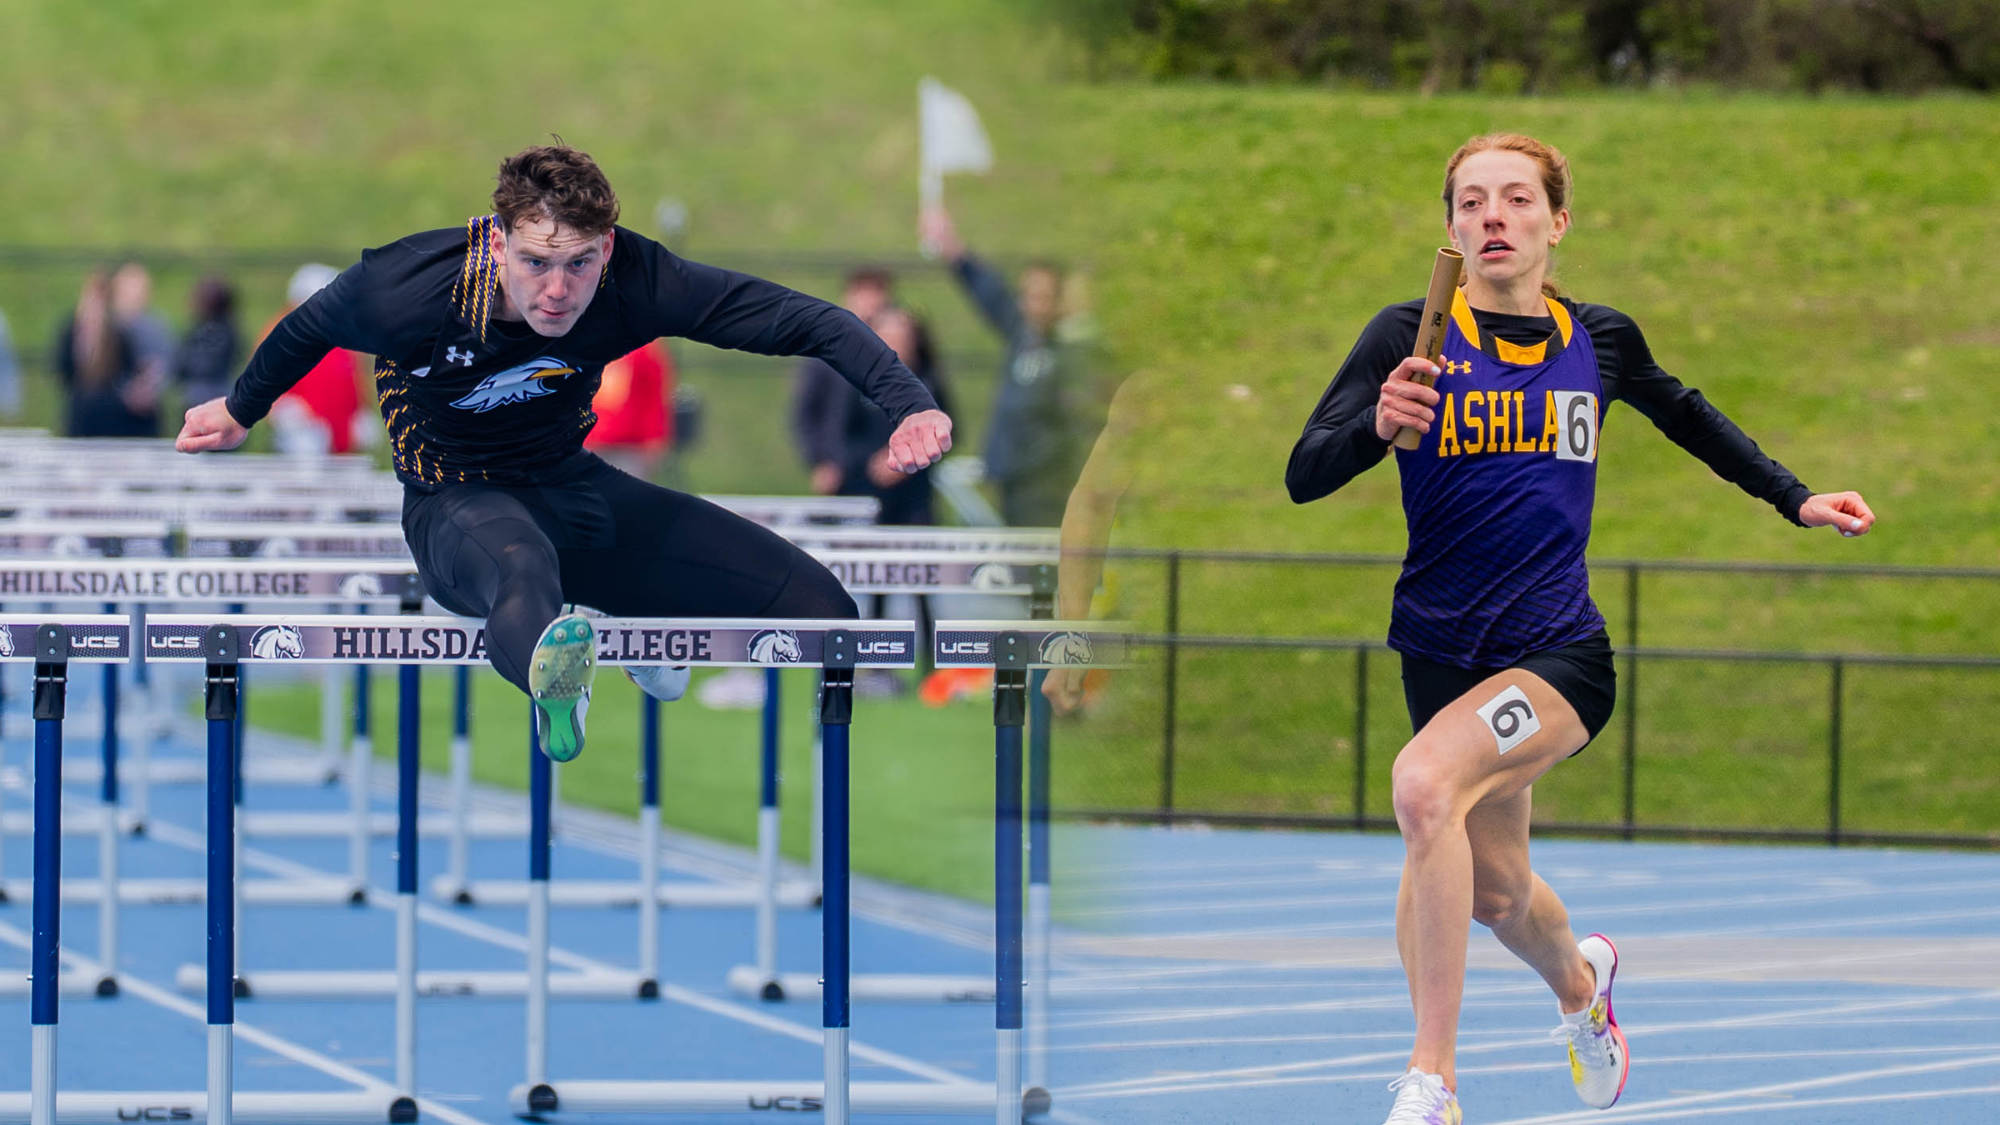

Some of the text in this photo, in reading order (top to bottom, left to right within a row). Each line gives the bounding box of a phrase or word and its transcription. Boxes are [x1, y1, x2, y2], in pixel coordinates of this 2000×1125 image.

[1438, 390, 1599, 460] ASHLA
[1567, 394, 1590, 457] 6
[828, 562, 941, 585] OLLEGE
[1, 570, 310, 597] HILLSDALE COLLEGE
[71, 635, 120, 648] UCS
[151, 635, 200, 648] UCS
[333, 627, 712, 661] HILLSDA LLEGE
[857, 641, 906, 654] UCS
[940, 641, 989, 654] UCS
[1491, 699, 1533, 739] 6
[748, 1096, 825, 1111] UCS
[117, 1106, 194, 1121] UCS
